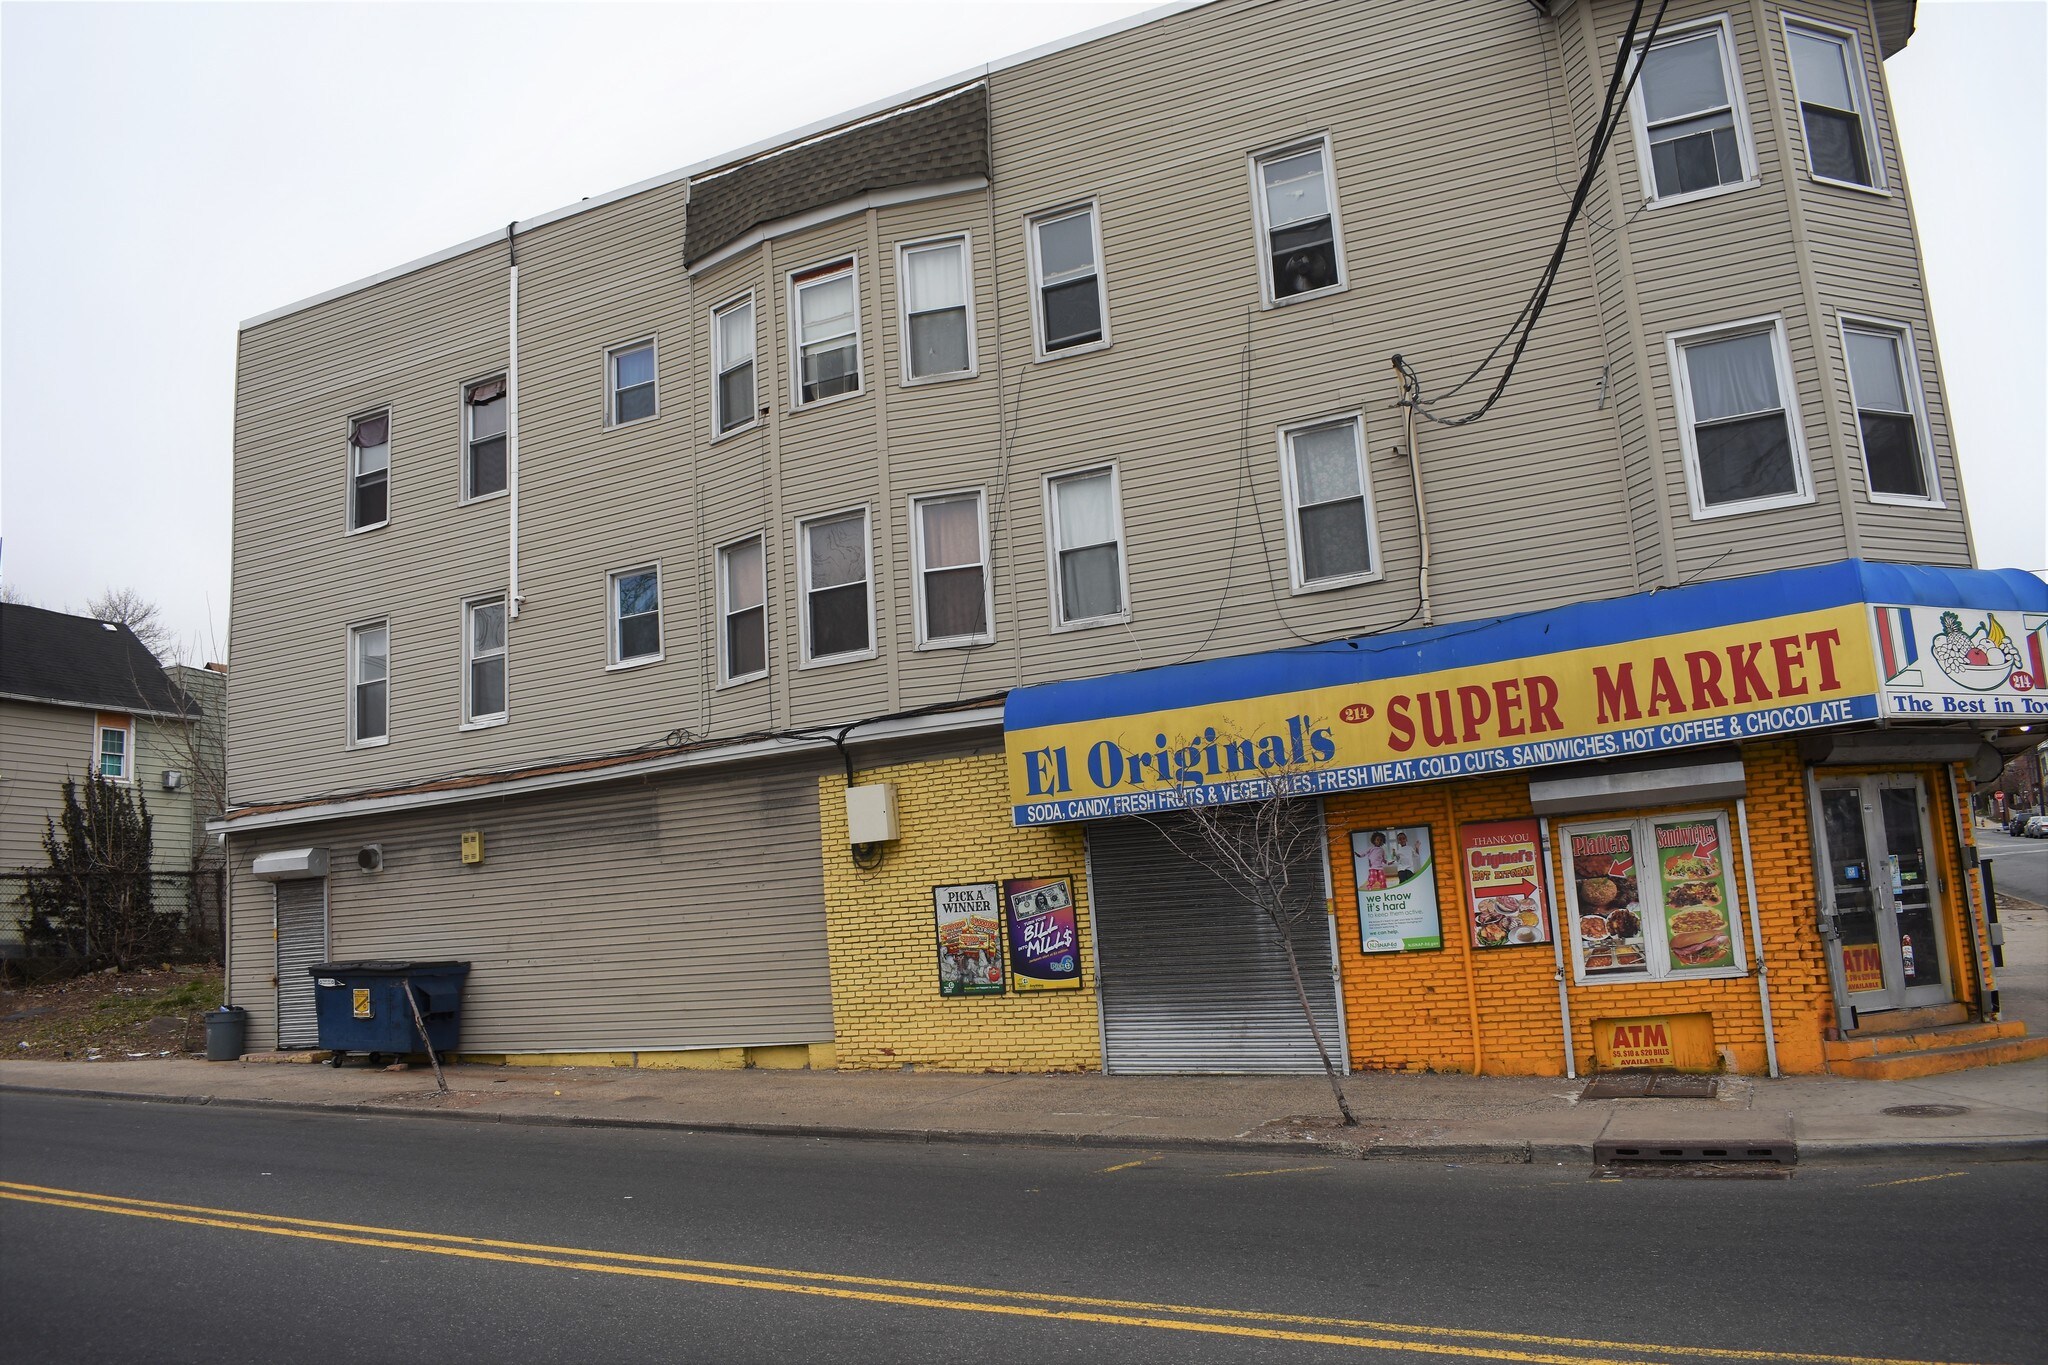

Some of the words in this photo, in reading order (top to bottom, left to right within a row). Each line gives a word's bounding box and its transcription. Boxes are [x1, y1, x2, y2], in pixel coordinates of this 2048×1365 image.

[1387, 675, 1564, 752] SUPER
[1592, 628, 1841, 724] MARKET
[2013, 675, 2031, 689] 214
[1345, 706, 1369, 720] 214
[1894, 695, 1933, 712] The
[1942, 696, 1987, 713] Best
[1994, 697, 2015, 713] in
[1022, 745, 1072, 797] El
[1087, 714, 1336, 790] Original's
[1027, 804, 1065, 823] SODA,
[1068, 798, 1111, 818] CANDY,
[1114, 793, 1156, 813] FRESH
[1159, 787, 1203, 808] FRUITS
[1208, 787, 1217, 802] &
[1221, 775, 1316, 801] VEGETABLES,
[1318, 767, 1368, 791] FRESH
[1370, 761, 1416, 784] MEAT,
[1419, 753, 1461, 778] COLD
[1464, 750, 1509, 771] CUTS,
[1513, 734, 1619, 767] SANDWICHES,
[1623, 728, 1655, 750] HOT
[1660, 716, 1726, 745] COFFEE
[1730, 716, 1743, 736] &
[1746, 699, 1853, 733] CHOCOLATE
[1473, 835, 1507, 845] THANK
[1508, 833, 1529, 842] YOU
[1656, 824, 1717, 848] Sandwiches
[1572, 834, 1630, 857] Platters
[1471, 850, 1533, 869] Original's
[1472, 870, 1490, 881] HOT
[1494, 865, 1534, 879] KITCHEN
[948, 891, 974, 902] PICK
[976, 890, 985, 900] A
[1366, 895, 1381, 903] we
[1384, 893, 1411, 901] know
[942, 901, 991, 913] WINNER
[1367, 904, 1380, 912] it's
[1383, 901, 1406, 911] hard
[1024, 916, 1058, 942] BILL
[1843, 948, 1880, 972] ATM
[1613, 1024, 1668, 1048] ATM
[1654, 1048, 1670, 1056] BILLS
